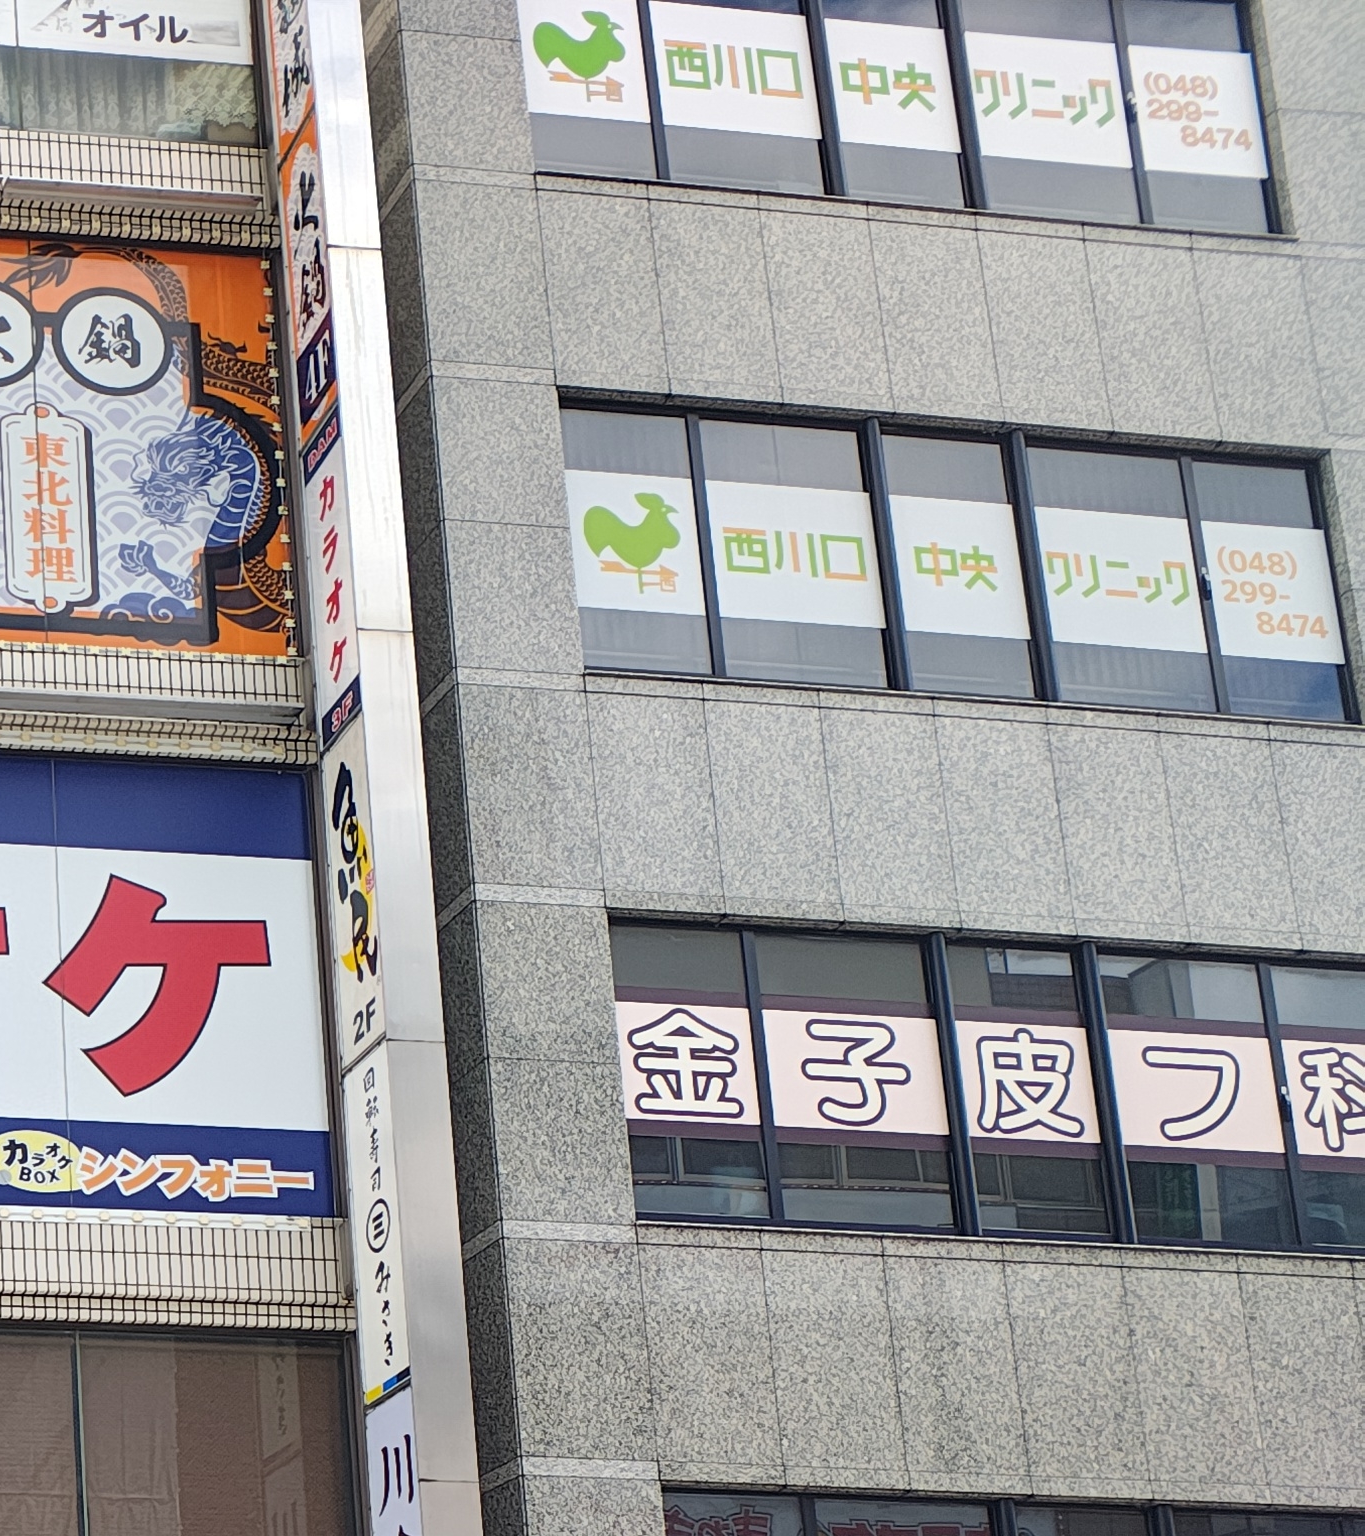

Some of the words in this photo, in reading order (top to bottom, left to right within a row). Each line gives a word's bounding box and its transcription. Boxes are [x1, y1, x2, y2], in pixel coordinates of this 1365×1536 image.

[82, 9, 188, 45] オイル
[663, 39, 802, 100] 西川口
[841, 57, 937, 113] 中央
[974, 68, 1116, 129] クリニック
[1142, 72, 1218, 101] (048)
[1146, 98, 1220, 123] 299-
[1180, 125, 1252, 151] 8474
[305, 336, 331, 404] 4F
[307, 415, 338, 472] DAM
[23, 433, 77, 582] 東北料理
[318, 476, 348, 683] カラオケ
[722, 527, 867, 581] 西川口
[914, 541, 998, 592] 中央
[1047, 549, 1189, 606] クリニック
[1216, 545, 1297, 580] (048)
[1222, 579, 1291, 606] 299-
[1256, 611, 1328, 639] 8474
[331, 695, 354, 733] 3F
[332, 762, 377, 983] 魚民
[352, 999, 377, 1045] 2F
[628, 1008, 1365, 1152] 金子皮フ科
[3, 1139, 72, 1171] カラオケ
[19, 1166, 60, 1184] BOX
[79, 1146, 314, 1201] シンフォニー
